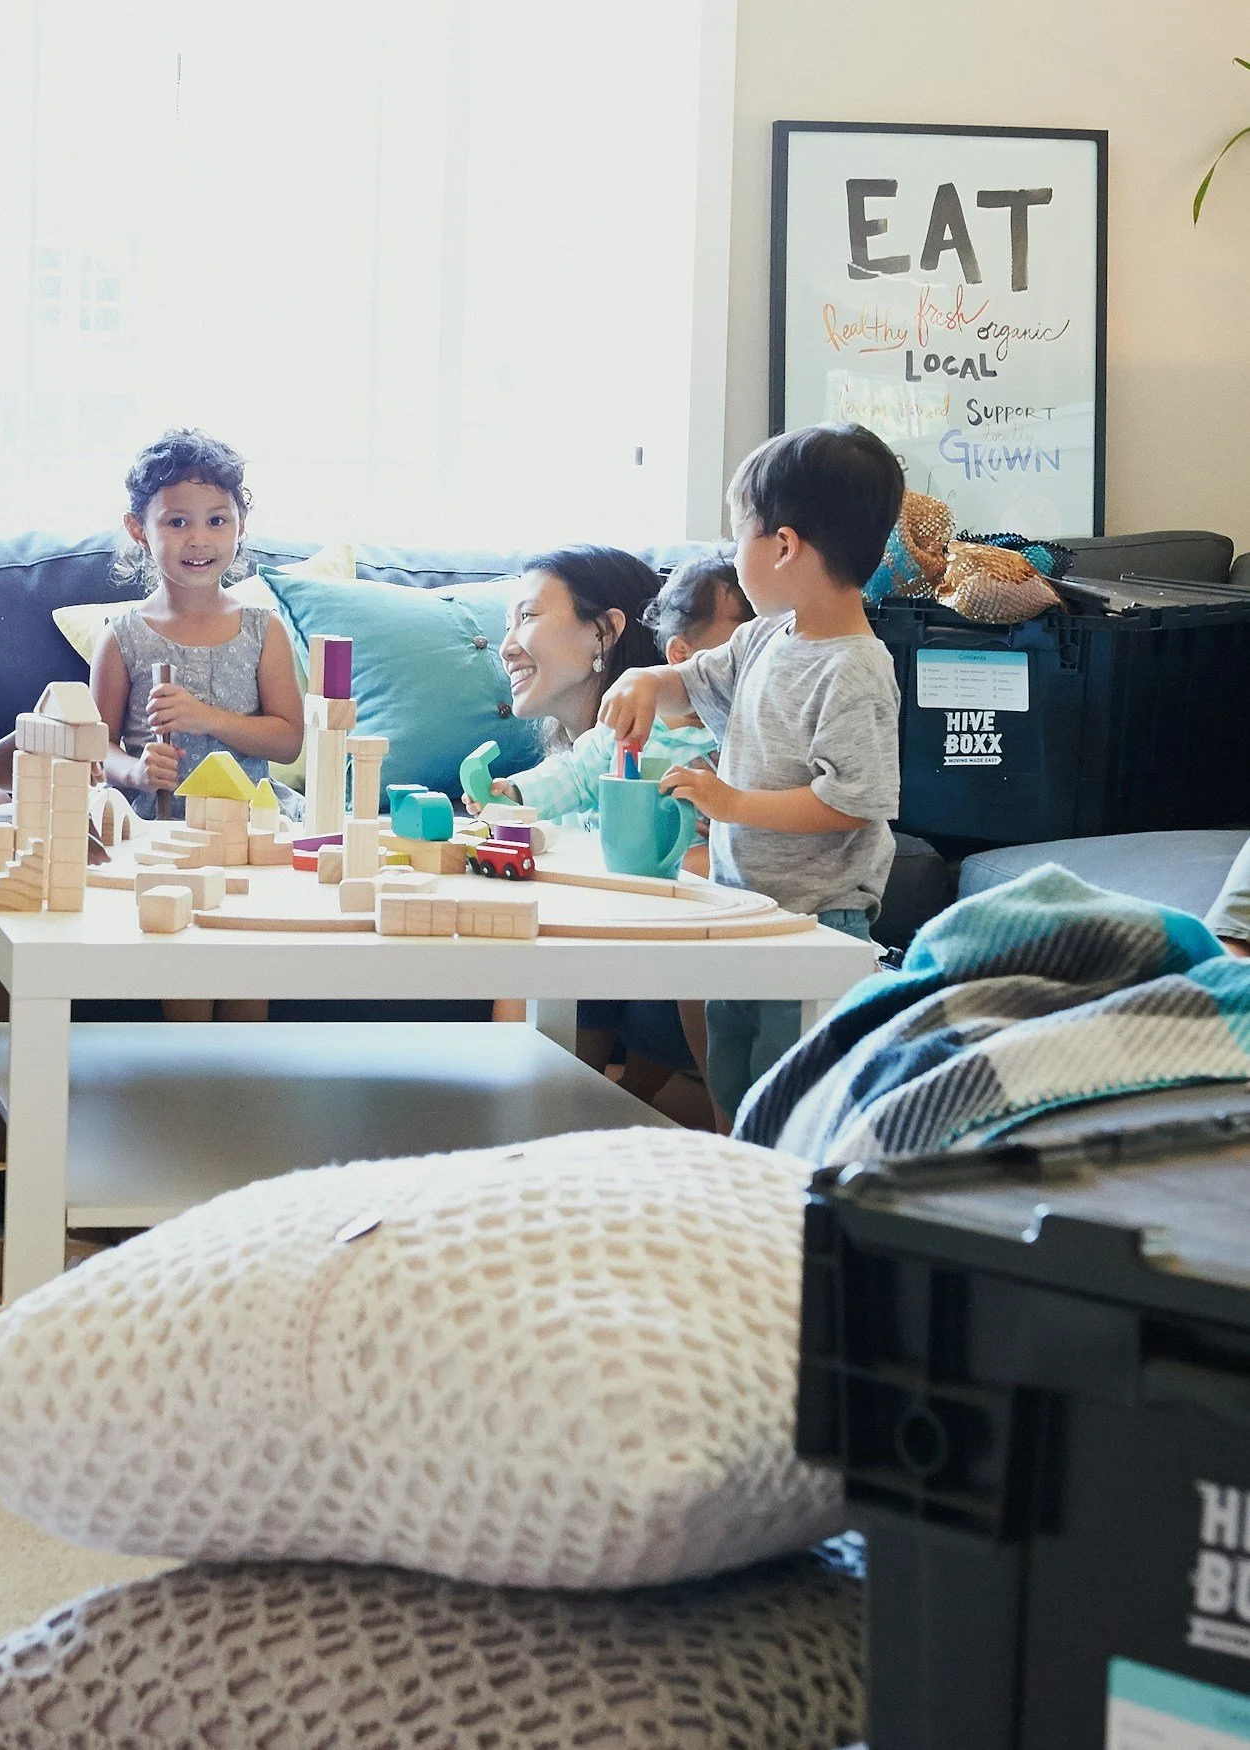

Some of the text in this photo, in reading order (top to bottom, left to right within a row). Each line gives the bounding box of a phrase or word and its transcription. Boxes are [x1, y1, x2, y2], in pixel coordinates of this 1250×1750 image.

[846, 178, 1053, 292] EAT
[917, 284, 990, 348] fresh
[976, 319, 1070, 362] organic
[904, 350, 998, 382] LOCAL
[966, 398, 1057, 426] SUPPORT
[939, 428, 1060, 483] GROWN
[958, 653, 987, 661] Contents
[944, 710, 996, 732] HIVE
[943, 733, 1003, 754] BOXX
